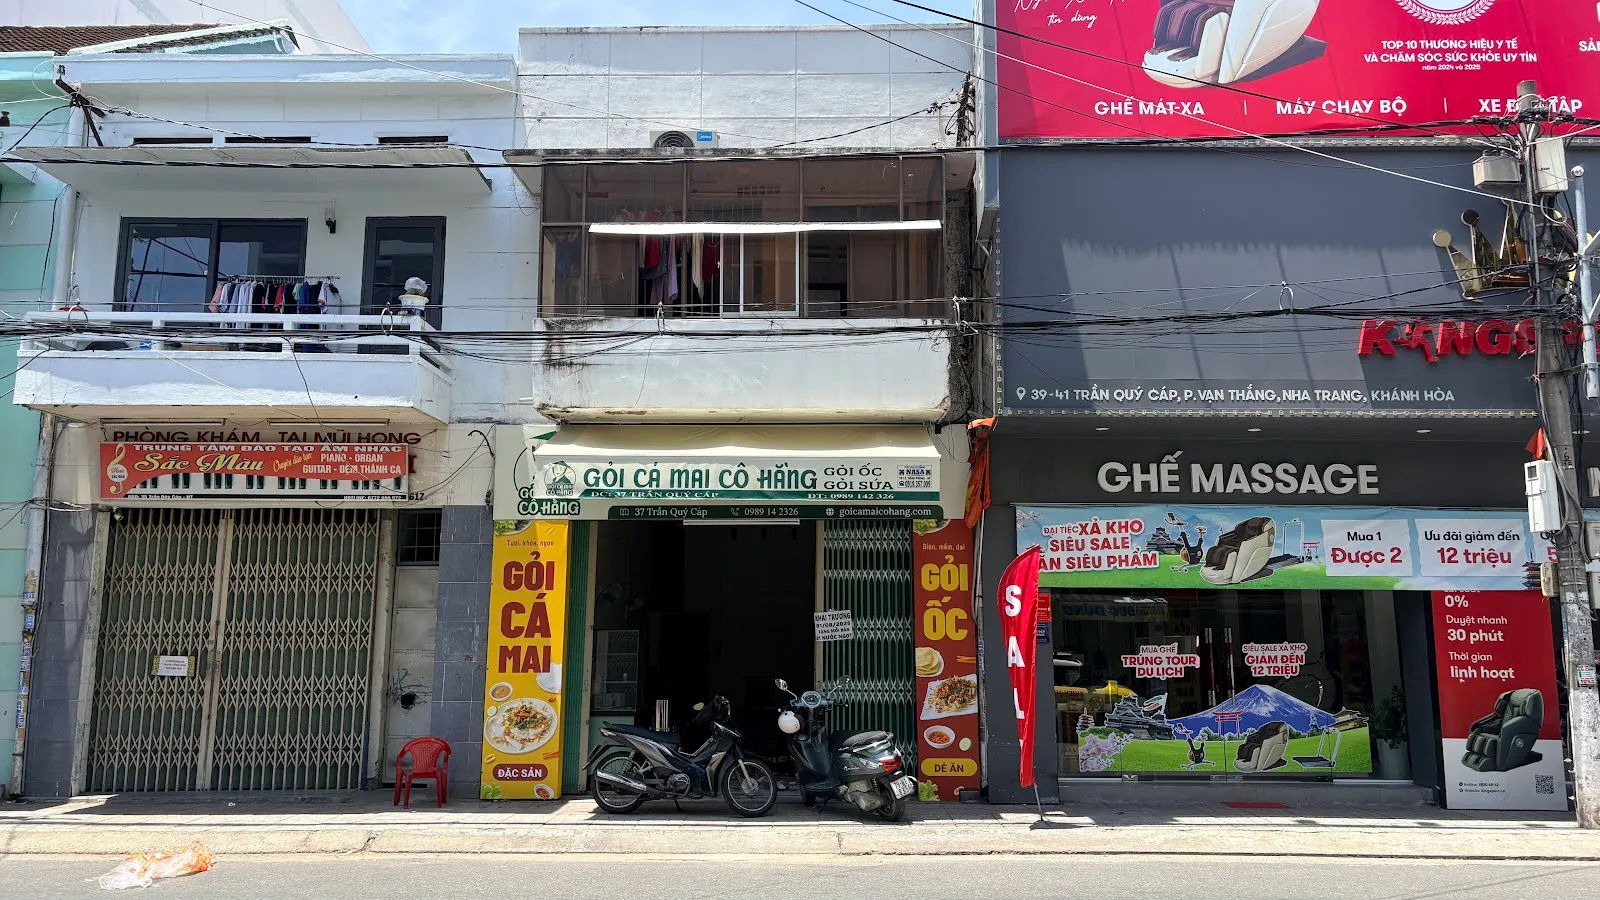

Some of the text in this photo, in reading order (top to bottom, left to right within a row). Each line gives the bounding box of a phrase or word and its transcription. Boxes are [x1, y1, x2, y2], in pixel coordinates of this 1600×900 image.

[1071, 10, 1097, 28] dùng
[1381, 37, 1518, 51] TOP 10 THƯƠNG HIỆU Y TẾ
[1364, 51, 1537, 64] VÀ CHĂM SÓC SỨC KHỎE UY TÍN
[1094, 97, 1205, 116] GHẾ MÁT-XA
[1276, 95, 1407, 117] MÁY CHẠY BỘ
[1478, 98, 1502, 113] XE
[1074, 384, 1110, 401] TRẦN
[1114, 386, 1143, 402] QUÝ
[1148, 385, 1181, 402] CÁP,
[1198, 389, 1225, 404] VẠN
[1228, 384, 1280, 403] THẮNG,
[1283, 389, 1312, 401] NHA
[1314, 389, 1368, 403] TRANG,
[1371, 386, 1420, 401] KHÁNH
[1424, 386, 1455, 402] HÒA
[114, 427, 260, 443] PHÒNG KHÁM
[133, 442, 402, 453] TRUNG TÂM ĐÀO TẠO ÂM NHẠC
[134, 453, 264, 472] Sắc Màu
[320, 453, 383, 463] PIANO ORGAN
[302, 465, 332, 474] GUITAR
[360, 463, 388, 474] THÁNH
[389, 464, 401, 474] CA
[583, 461, 817, 490] GỎI CÁ MAI CÔ HẰNG
[824, 462, 882, 476] GỎI ỐC
[1096, 450, 1379, 495] GHẾ MASSAGE
[824, 477, 893, 490] GỎI SỨA
[409, 492, 424, 501] 617
[630, 489, 662, 498] TRẦN
[666, 490, 691, 498] QUÝ
[694, 490, 719, 498] CÁP
[518, 498, 580, 515] CÔ HẰNG
[635, 507, 708, 517] 37 Trần Quý Cáp
[744, 507, 799, 516] 0989 14 2326
[839, 507, 932, 517] goicamaicohang.com
[1043, 526, 1058, 536] ĐẠI
[1078, 517, 1102, 535] XẢ
[1106, 519, 1143, 534] KHO
[1347, 531, 1382, 541] Mua 1
[1424, 530, 1520, 544] Ưu đãi giảm đến
[1049, 536, 1130, 552] SIÊU SALE
[1039, 547, 1158, 571] ĂN SIÊU PHẨM
[1331, 546, 1403, 568] Được 2
[1437, 547, 1512, 568] 12 triệu
[502, 551, 555, 591] GỎI
[920, 554, 969, 592] GỎI
[1444, 594, 1469, 608] 0%
[500, 592, 552, 639] CÁ
[923, 595, 968, 641] ỐC
[1446, 614, 1508, 626] Duyệt nhanh
[1447, 628, 1504, 645] 30 phút
[1141, 642, 1176, 654] MUA GHẾ
[1243, 643, 1307, 653] SIÊU SALE XẢ KHO
[498, 645, 551, 674] MAI
[1123, 653, 1196, 666] TRÚNG TOUR
[1246, 653, 1304, 665] GIẢM ĐẾN
[1448, 651, 1493, 663] Thời gian
[1137, 667, 1183, 680] DU LỊCH
[1251, 664, 1299, 678] 12 TRIỆU
[1450, 665, 1515, 682] linh hoạt
[497, 765, 542, 779] ĐẶC SẢN
[950, 762, 964, 772] ĂN
